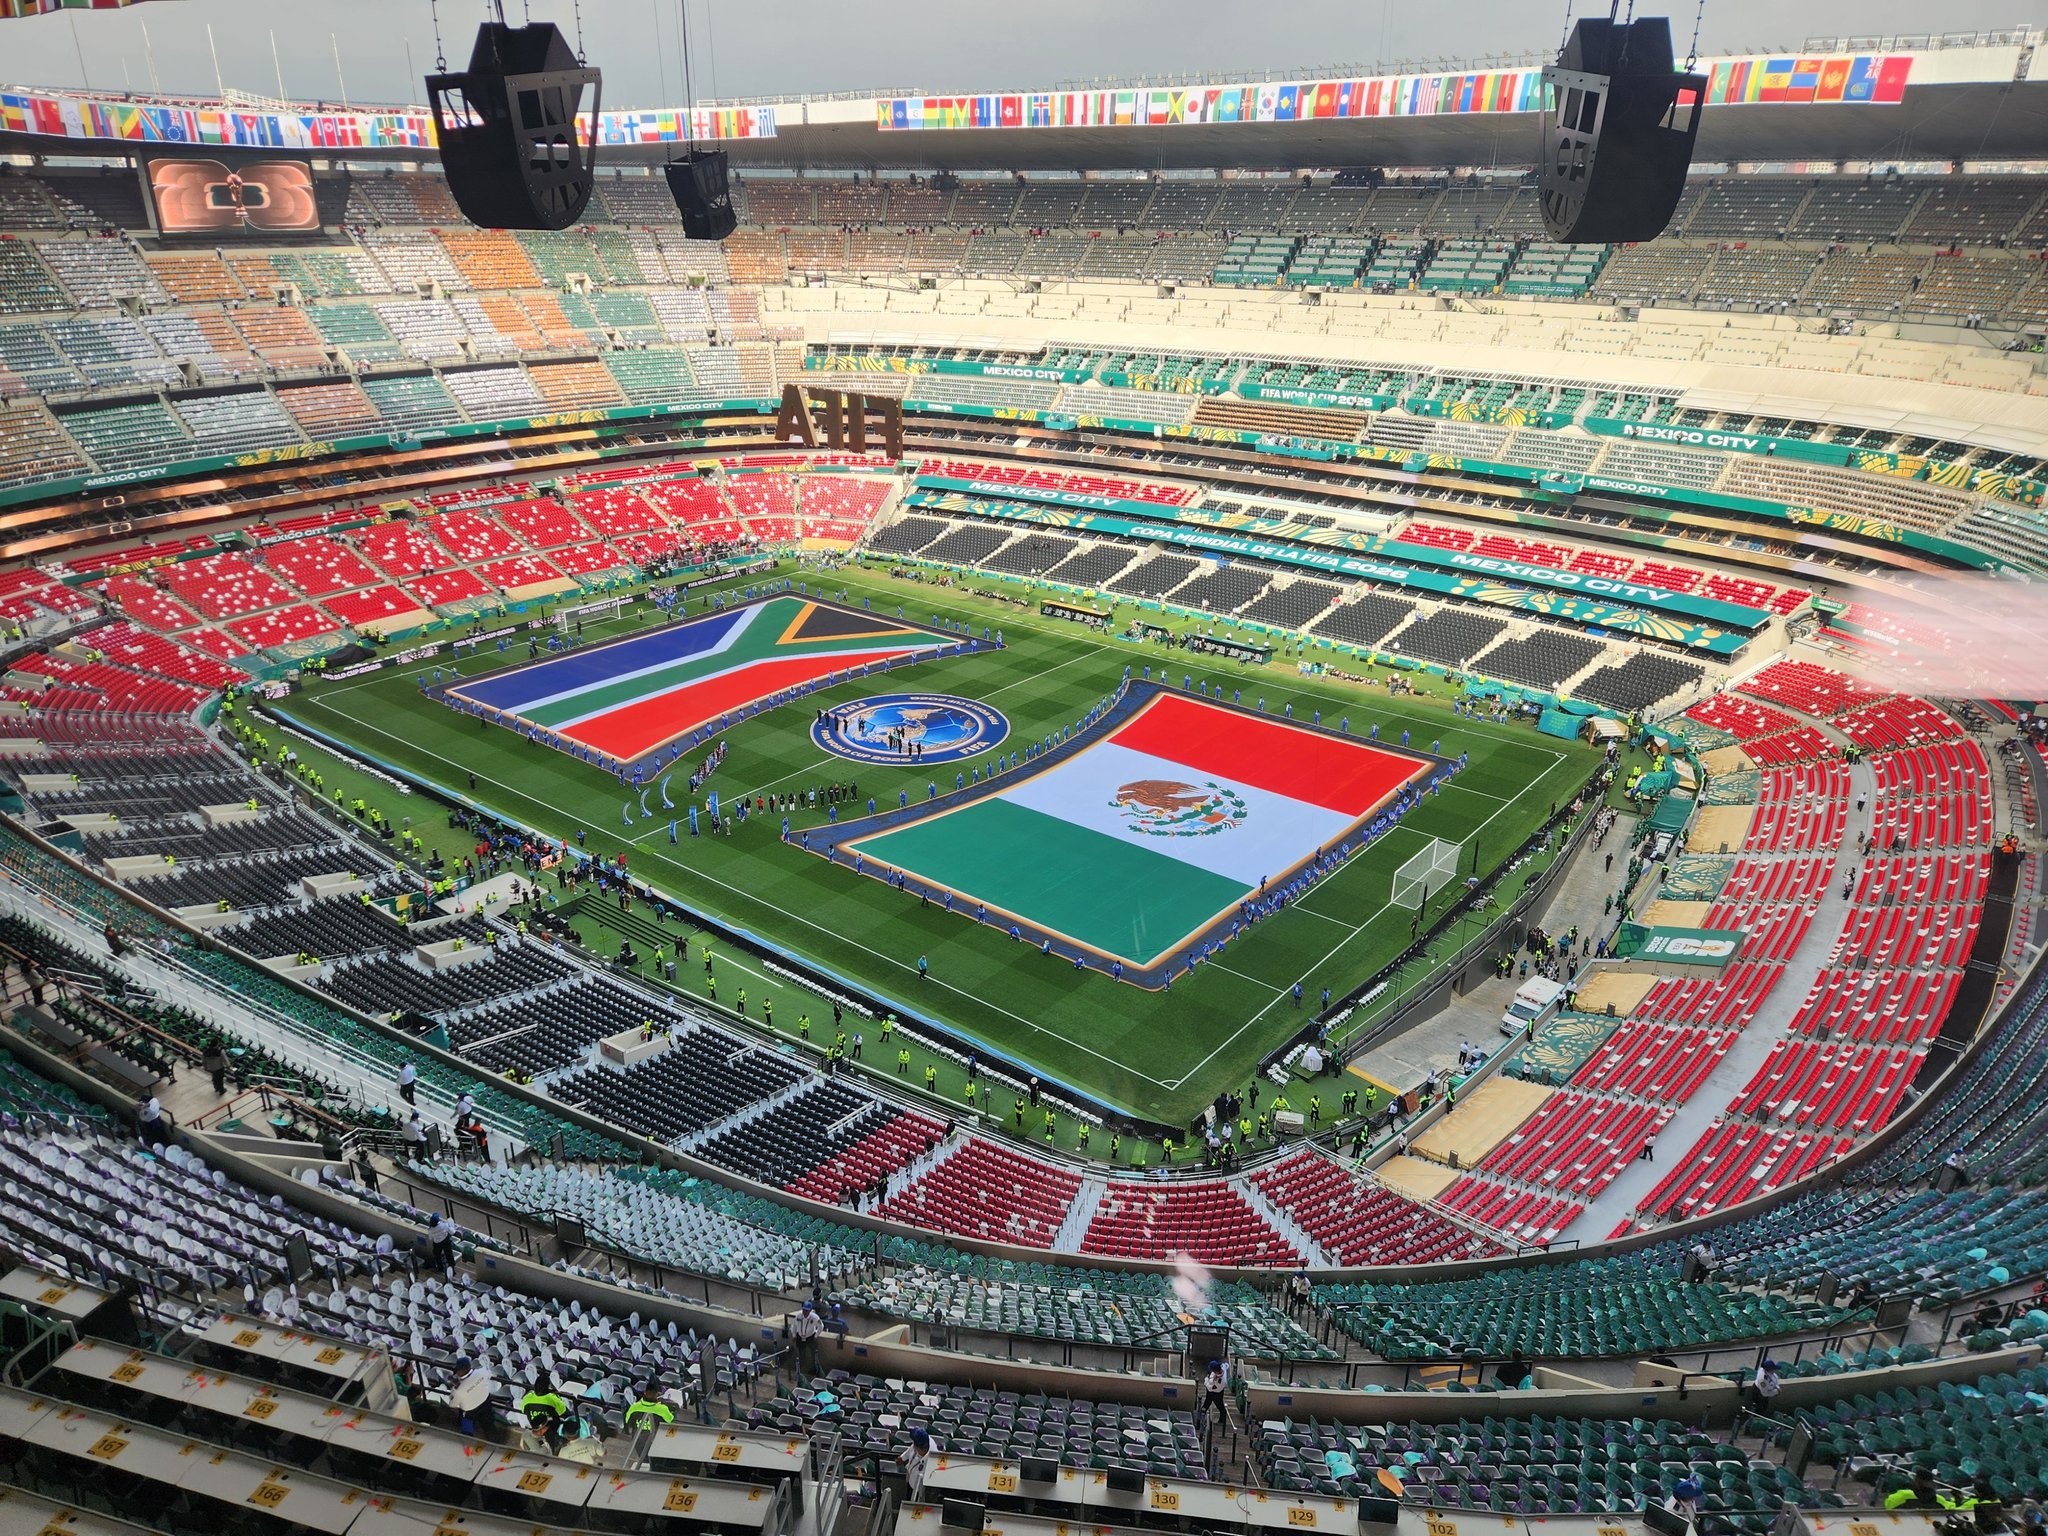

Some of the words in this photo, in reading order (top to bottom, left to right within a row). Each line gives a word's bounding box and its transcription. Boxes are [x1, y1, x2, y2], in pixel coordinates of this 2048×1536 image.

[983, 366, 1032, 379] MEXICO
[1035, 370, 1065, 381] CITY
[1261, 388, 1281, 399] FIFA
[1318, 393, 1338, 404] CUP
[1338, 395, 1373, 407] 2026
[667, 403, 697, 412] MEXICO
[700, 402, 723, 410] CITY
[1624, 424, 1703, 444] MEXICO
[1707, 434, 1759, 450] CITY
[87, 472, 137, 486] MEXICO
[138, 467, 167, 478] CITY
[622, 476, 656, 485] MEXICO
[969, 481, 1058, 500] MEXICO
[1061, 490, 1120, 506] CITY
[1589, 478, 1638, 492] MEXICO
[1639, 486, 1668, 496] CITY
[460, 500, 481, 509] WORLD
[261, 531, 303, 545] MEXICO
[304, 526, 329, 536] CITY
[1130, 526, 1173, 540] COPA
[1174, 532, 1249, 551] MUNDIAL
[1250, 542, 1274, 555] DE
[1276, 548, 1299, 560] LA
[1301, 551, 1340, 567] FIFA
[1341, 560, 1410, 580] 2026
[1450, 554, 1580, 585] MEXICO
[1584, 576, 1675, 602] CITY
[959, 739, 991, 755] FIFA
[239, 1332, 256, 1344] 160
[321, 1351, 339, 1360] 159
[117, 1366, 139, 1377] 164
[251, 1401, 274, 1414] 163
[97, 1438, 125, 1452] 167
[397, 1441, 419, 1454] 162
[717, 1446, 738, 1457] 132
[524, 1473, 548, 1487] 137
[992, 1477, 1013, 1487] 131
[256, 1486, 284, 1501] 166
[1154, 1494, 1177, 1505] 130
[670, 1494, 693, 1507] 136
[1291, 1510, 1313, 1521] 129
[1431, 1524, 1453, 1535] 102
